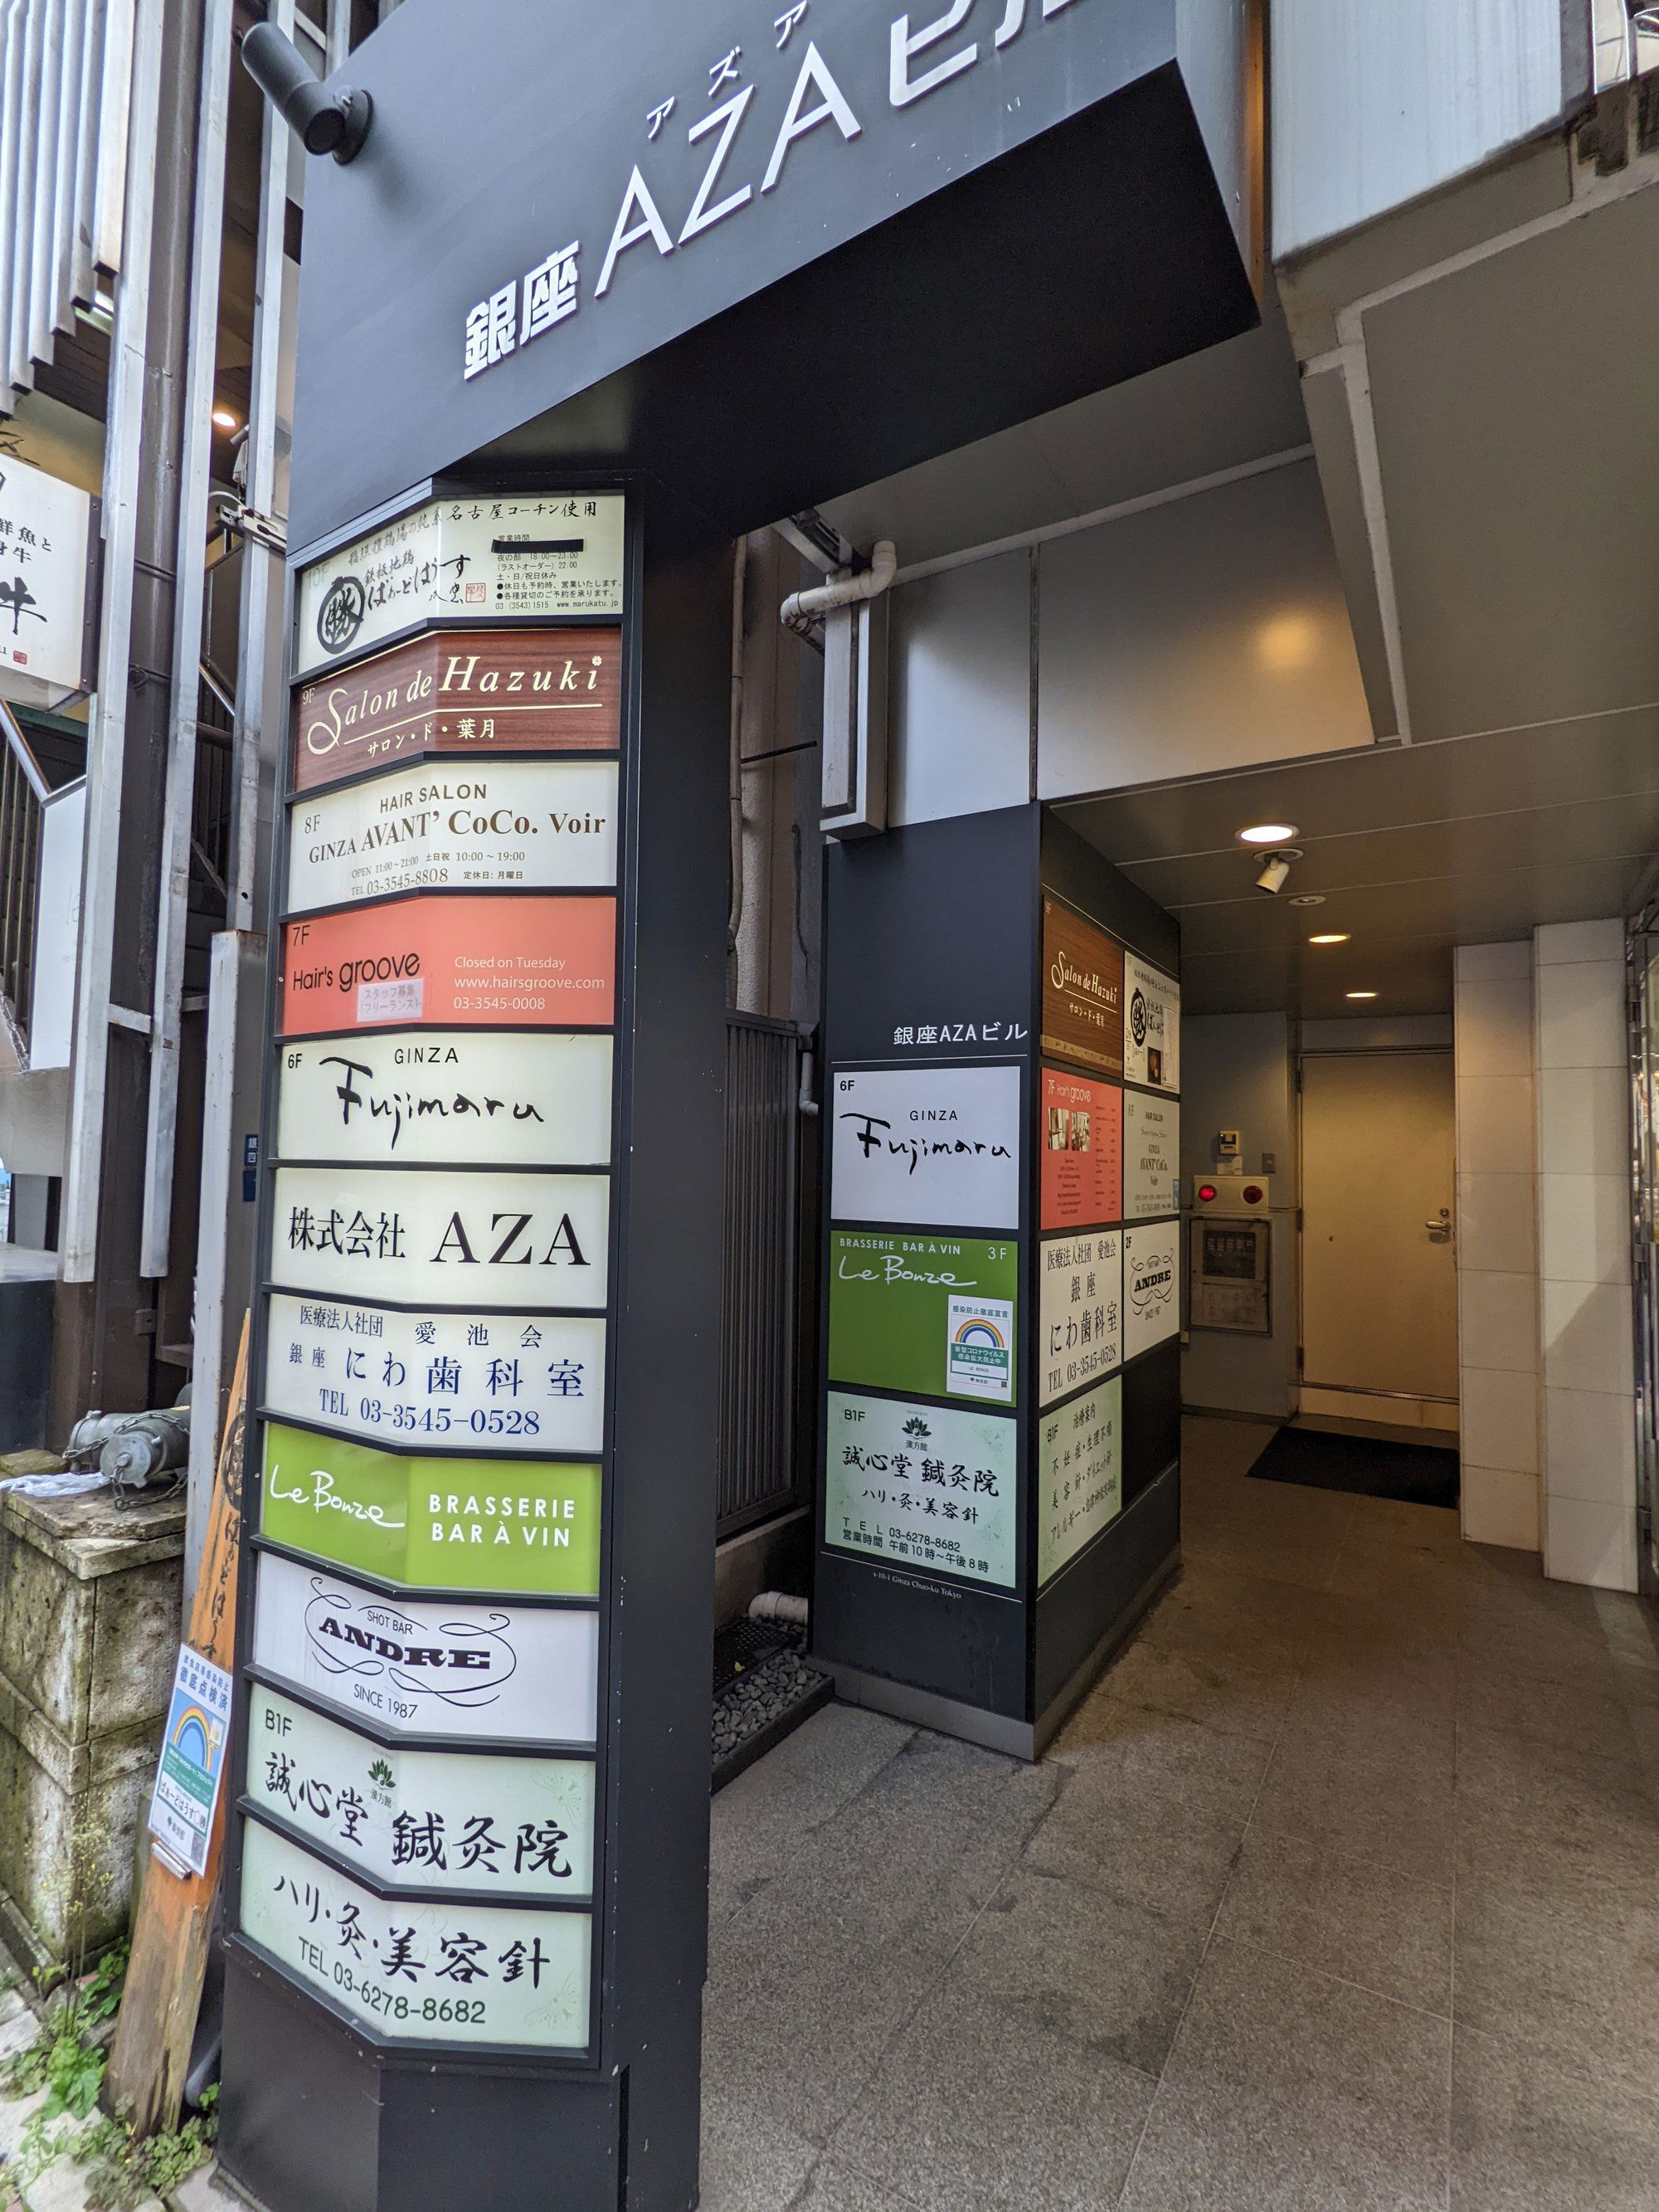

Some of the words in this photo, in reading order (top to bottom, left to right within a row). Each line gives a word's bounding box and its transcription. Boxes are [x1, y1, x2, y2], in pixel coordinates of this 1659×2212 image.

[302, 686, 315, 705] 9F
[307, 687, 398, 755] Salon
[406, 669, 433, 704] de
[438, 655, 603, 694] Hazuki
[367, 719, 496, 758] サロン・ド・葉月
[380, 791, 414, 814] HAIR
[419, 783, 488, 804] SALON
[304, 814, 321, 835] 8F
[309, 836, 358, 865] GINZA
[447, 809, 538, 836] CoCo.
[548, 812, 606, 835] Voir
[351, 865, 372, 879] OPEN
[425, 851, 450, 863] 土日祝
[455, 851, 484, 863] 10:00
[498, 850, 526, 862] 19:00
[351, 885, 366, 898] TEL
[367, 867, 449, 896] 03-3545-8808
[292, 924, 311, 947] 7F
[293, 966, 334, 992] Hair's
[339, 953, 421, 994] groove
[455, 956, 495, 970] Closed
[498, 959, 513, 969] on
[515, 957, 567, 973] Tuesday
[1051, 951, 1082, 989] Salon
[1082, 973, 1091, 991] de
[1092, 973, 1117, 1004] Hazuki
[455, 975, 606, 992] www.hairsgroove.com
[453, 996, 546, 1011] 03-3545-0008
[893, 1021, 1029, 1045] 銀座AZAビル
[287, 1053, 303, 1069] 6F
[394, 1047, 460, 1065] GINZA
[839, 1079, 856, 1092] 6F
[1048, 1079, 1055, 1095] 7F
[1070, 1087, 1091, 1104] groove
[319, 1056, 545, 1151] Fujimaru
[909, 1110, 959, 1122] GINZA
[839, 1113, 1012, 1177] Fujimaru
[288, 1206, 406, 1259] 株式会社
[429, 1211, 591, 1266] AZA
[839, 1237, 895, 1251] BRASSERIE
[902, 1241, 925, 1253] BAR
[940, 1244, 961, 1255] VIN
[1125, 1236, 1132, 1249] 2F
[839, 1255, 880, 1281] Le
[1047, 1242, 1092, 1272] 医療法人社団
[1070, 1271, 1097, 1303] 銀座
[1134, 1269, 1171, 1293] ANDRE
[299, 1304, 383, 1338] 医療法人社団
[415, 1320, 543, 1349] 愛池会
[1049, 1300, 1117, 1357] にわ歯科室
[289, 1342, 326, 1369] 銀座
[345, 1346, 585, 1397] にわ歯科室
[1048, 1367, 1063, 1393] TEL
[1067, 1342, 1117, 1382] 03-3545-0528
[319, 1388, 350, 1417] TEL
[360, 1396, 541, 1435] 03-3545-0528
[844, 1409, 866, 1422] B1F
[841, 1445, 912, 1479] 誠心堂
[270, 1464, 310, 1503] Le
[428, 1493, 575, 1518] BRASSERIE
[431, 1523, 484, 1543] BAR
[494, 1520, 511, 1545] À
[522, 1526, 571, 1547] VIN
[842, 1528, 883, 1548] 営業時間
[888, 1527, 961, 1552] 03-6278-8682
[892, 1576, 911, 1586] Ginza
[941, 1587, 962, 1599] Tokyo
[366, 1610, 391, 1630] SHOT
[392, 1619, 414, 1635] BAR
[319, 1616, 492, 1670] ANDRE
[353, 1683, 384, 1710] SINCE
[387, 1697, 419, 1719] 1987
[264, 1708, 293, 1737] B1F
[265, 1751, 369, 1847] 誠心堂
[392, 1809, 574, 1878] 鍼灸院
[298, 1935, 329, 1976] TEL
[333, 1963, 487, 2024] 03-6278-8682
